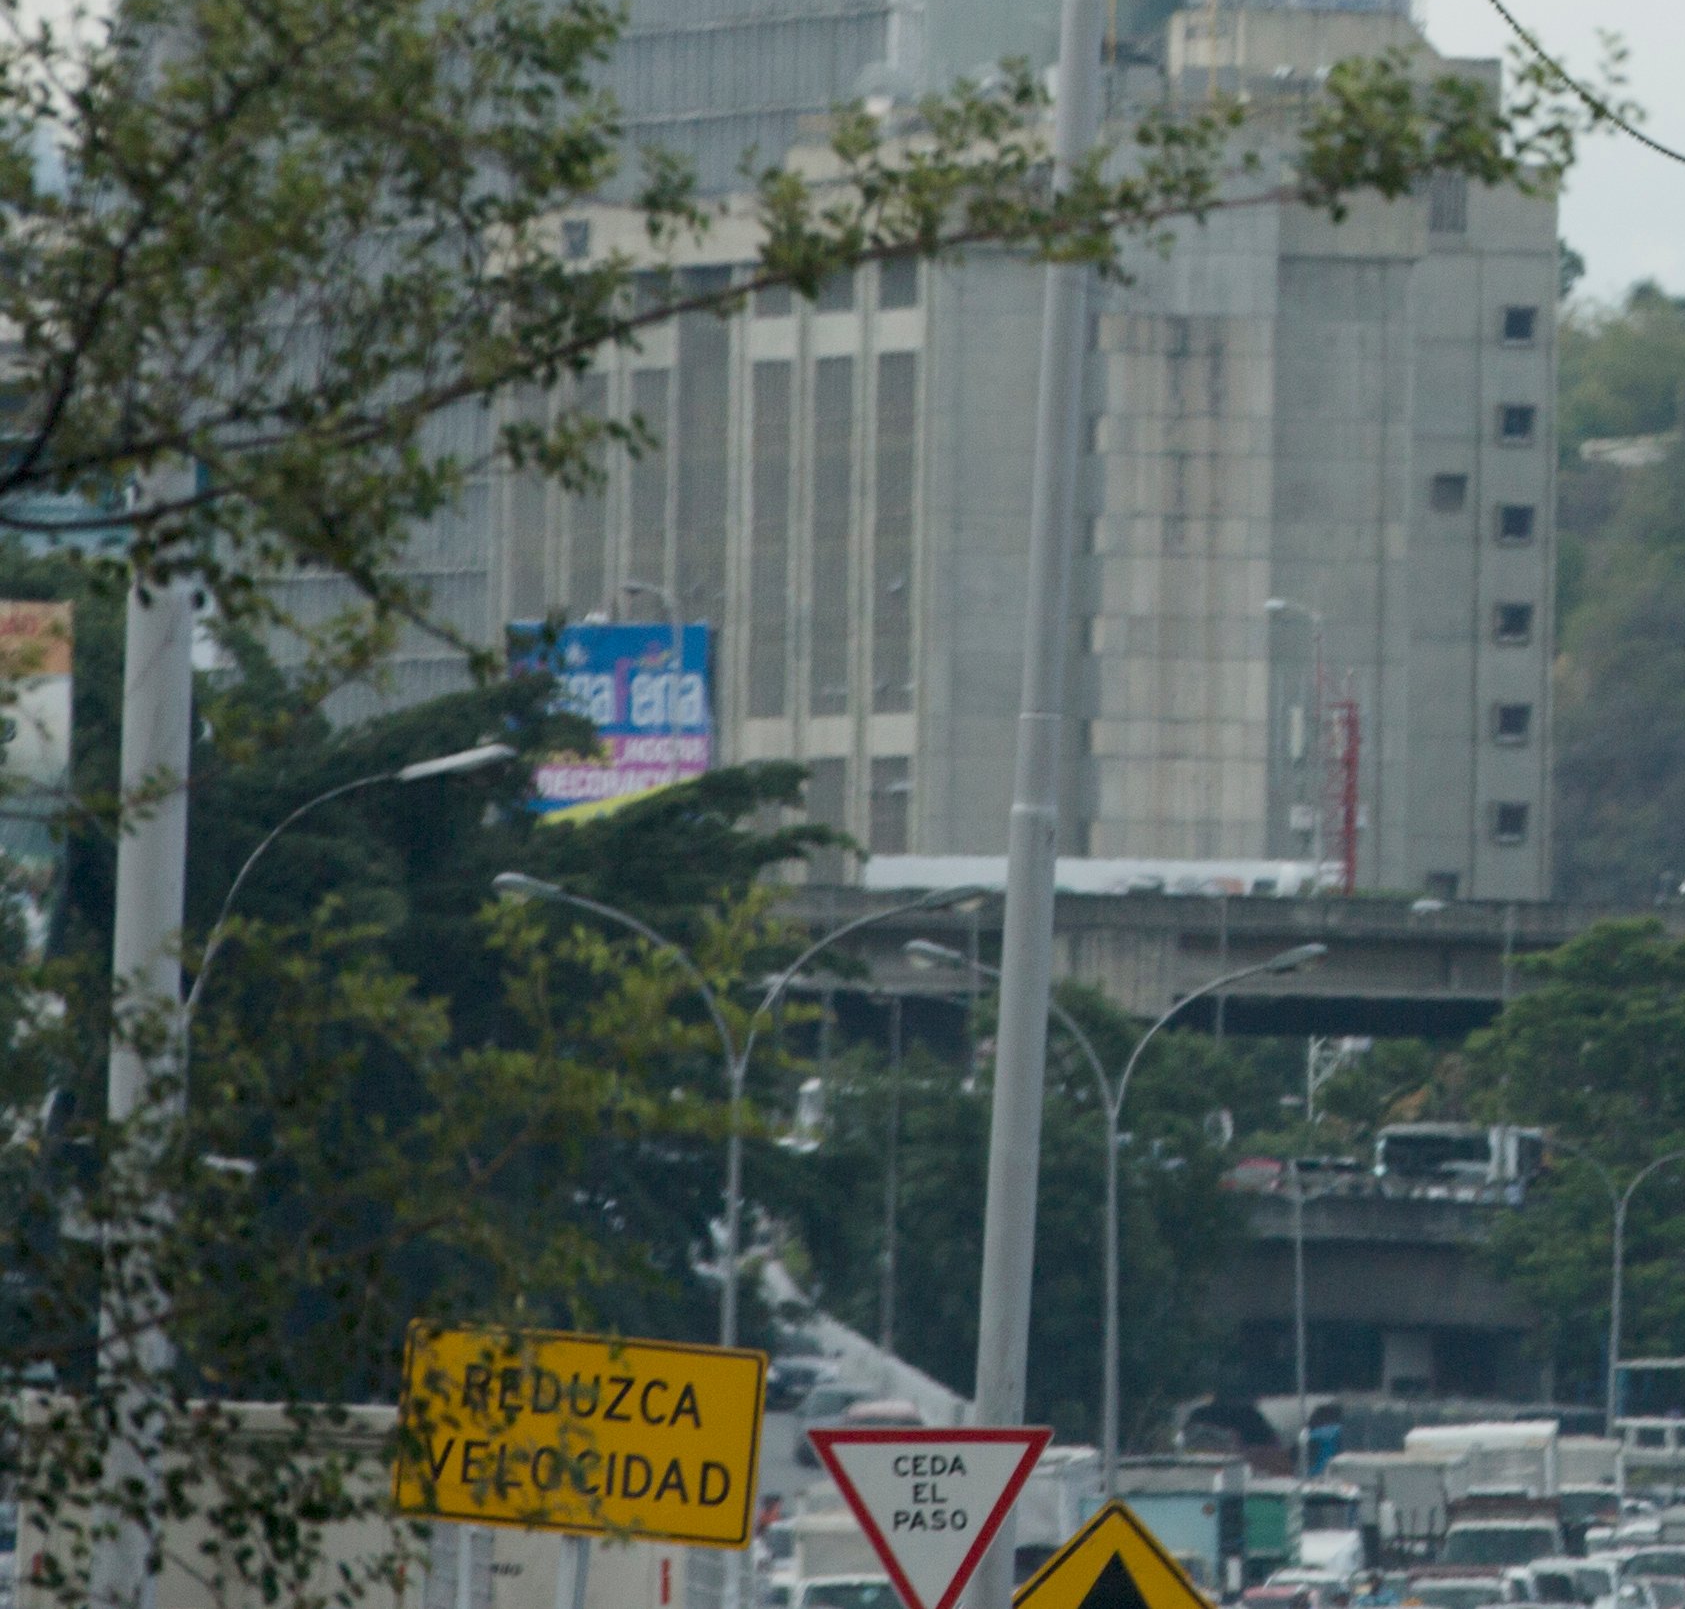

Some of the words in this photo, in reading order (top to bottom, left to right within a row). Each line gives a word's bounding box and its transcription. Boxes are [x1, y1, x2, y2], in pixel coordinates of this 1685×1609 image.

[461, 1364, 702, 1429] REDUZCA
[424, 1438, 732, 1507] VELOCIDAD
[893, 1454, 967, 1477] CEDA
[912, 1482, 948, 1504] EL
[893, 1508, 968, 1531] PASO
